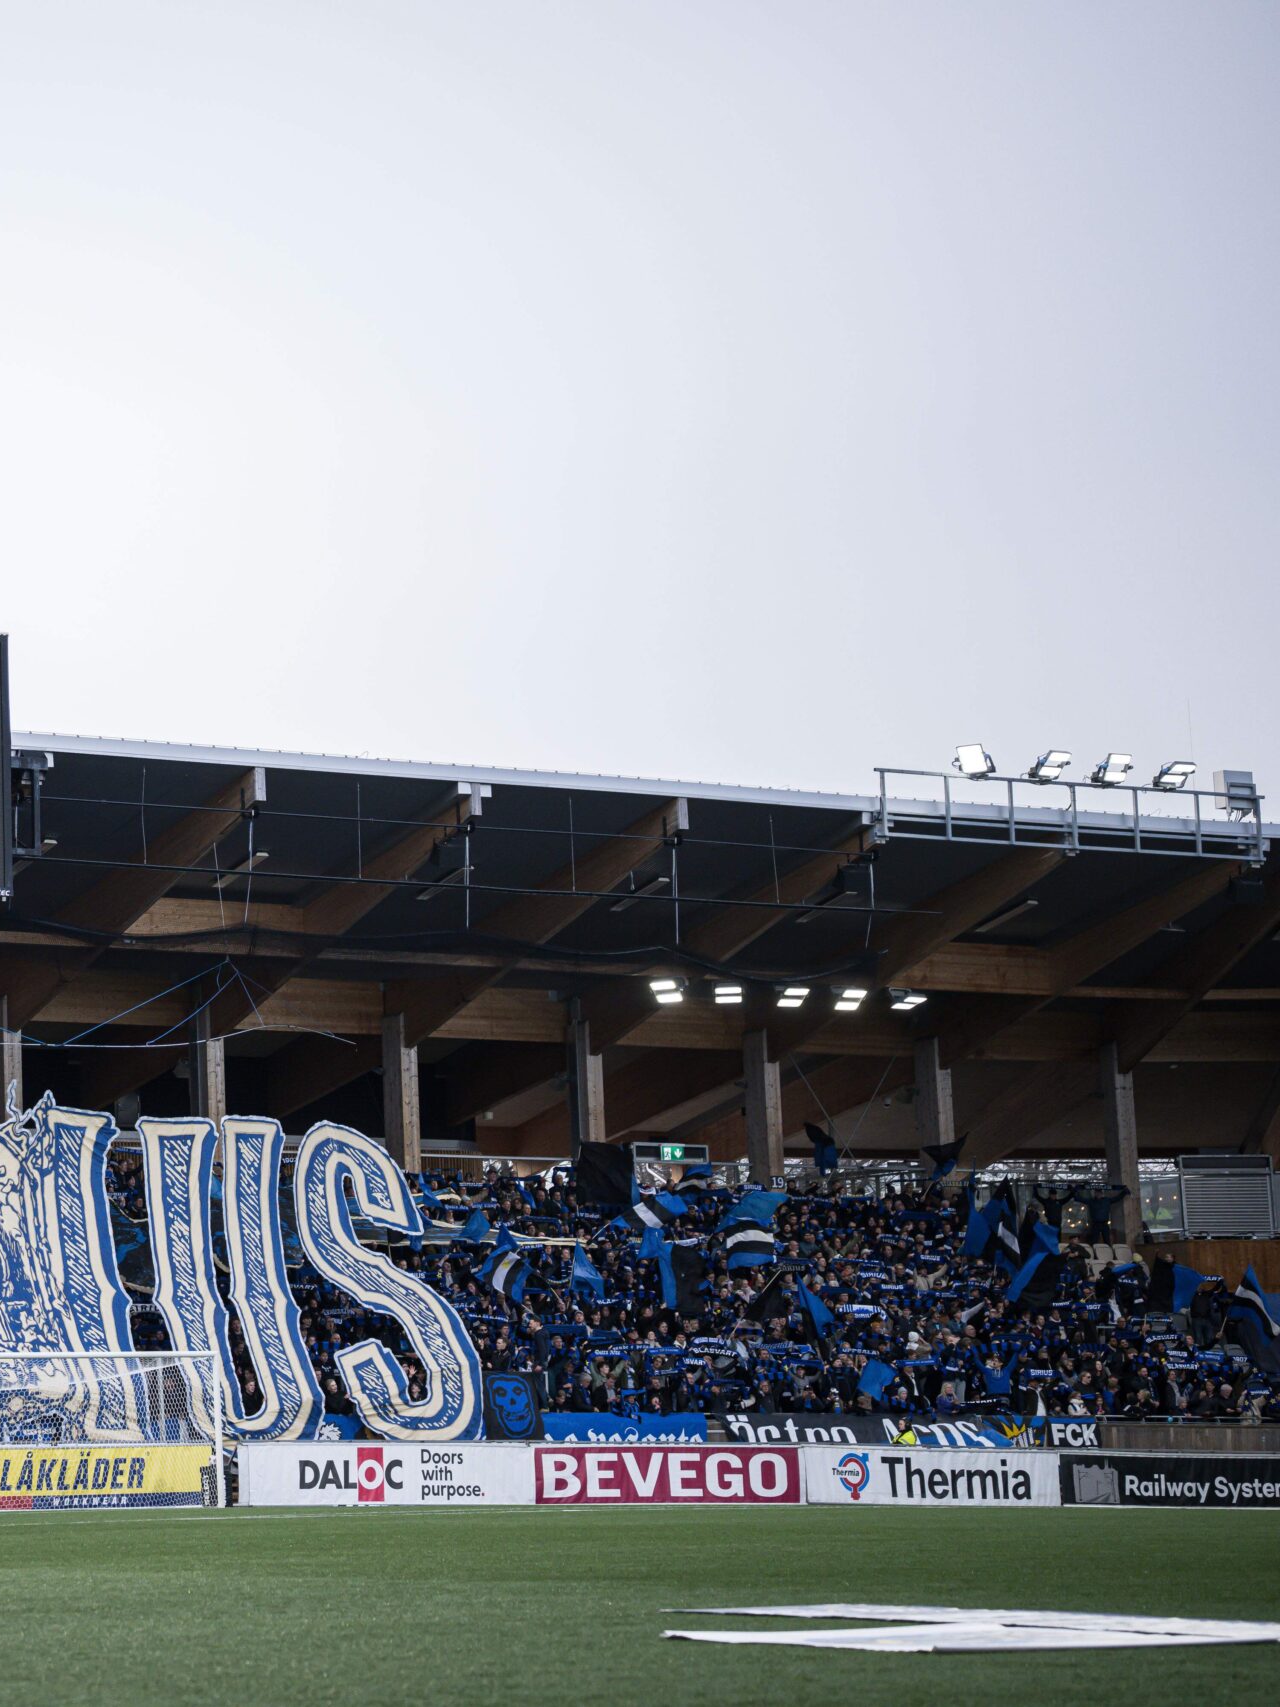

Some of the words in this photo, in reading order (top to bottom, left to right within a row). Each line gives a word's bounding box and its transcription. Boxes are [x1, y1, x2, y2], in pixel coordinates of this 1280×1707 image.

[771, 1176, 784, 1189] 19
[1029, 1368, 1054, 1377] SIRIUS
[1051, 1423, 1099, 1447] FCK
[420, 1449, 464, 1465] Doors
[298, 1459, 403, 1490] DALOC
[421, 1466, 453, 1482] with
[540, 1452, 789, 1499] BEVEGO
[832, 1467, 860, 1478] Thermia
[880, 1457, 1031, 1500] Thermia
[421, 1483, 485, 1500] purpose.
[1125, 1474, 1210, 1503] Railway
[52, 1495, 128, 1507] WORKWEAR
